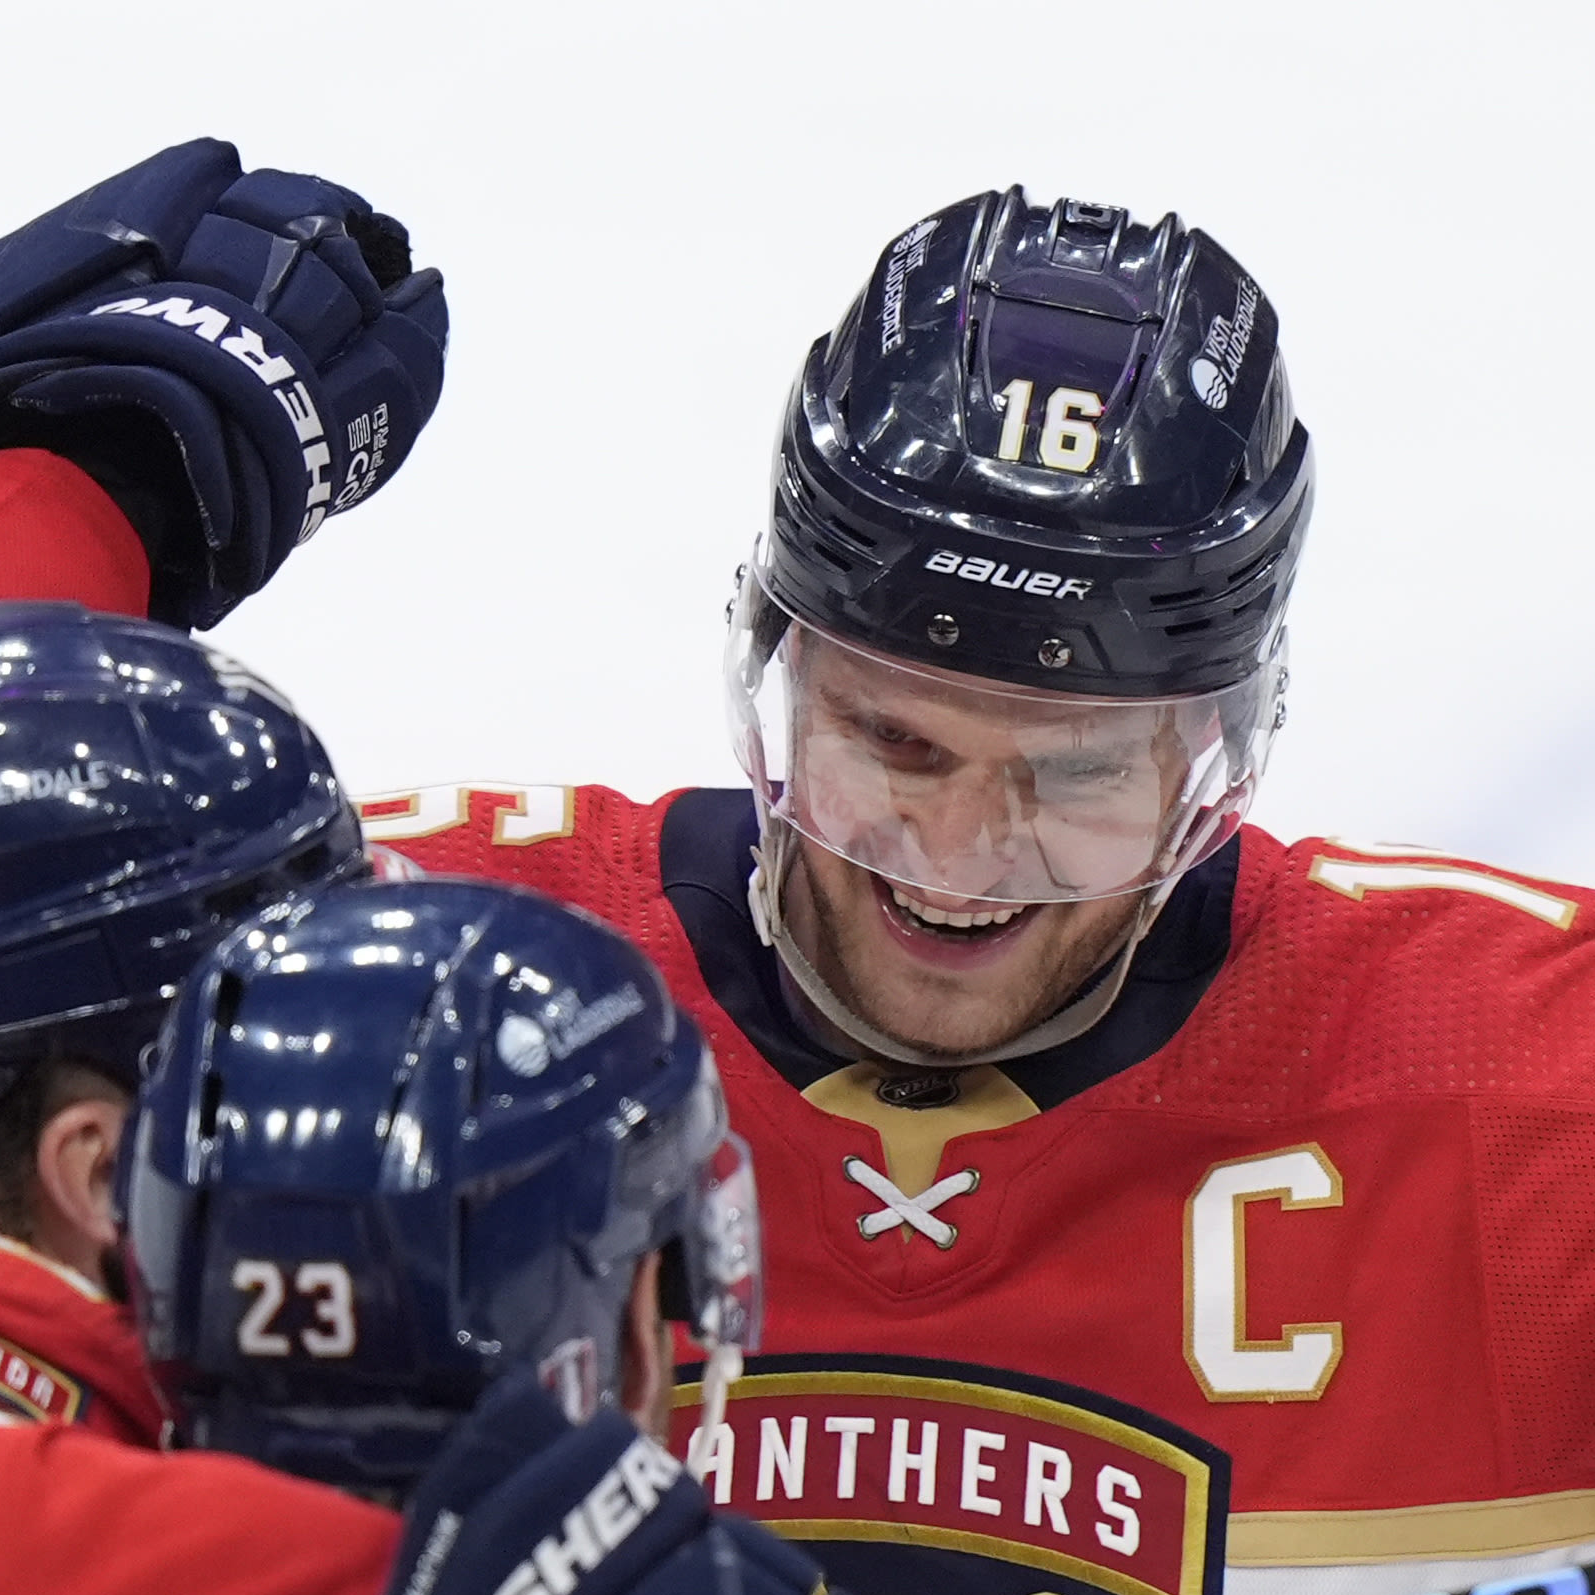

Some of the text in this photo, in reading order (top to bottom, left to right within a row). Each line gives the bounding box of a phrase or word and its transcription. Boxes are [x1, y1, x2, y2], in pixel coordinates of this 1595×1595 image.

[880, 250, 911, 356] LAUDERDALE
[1203, 314, 1232, 364] VISIT
[1219, 279, 1258, 388] LAUDERDALE
[992, 378, 1107, 473] 16
[924, 549, 1095, 601] BAUER
[231, 1259, 360, 1358] 23
[1183, 1141, 1343, 1402] C
